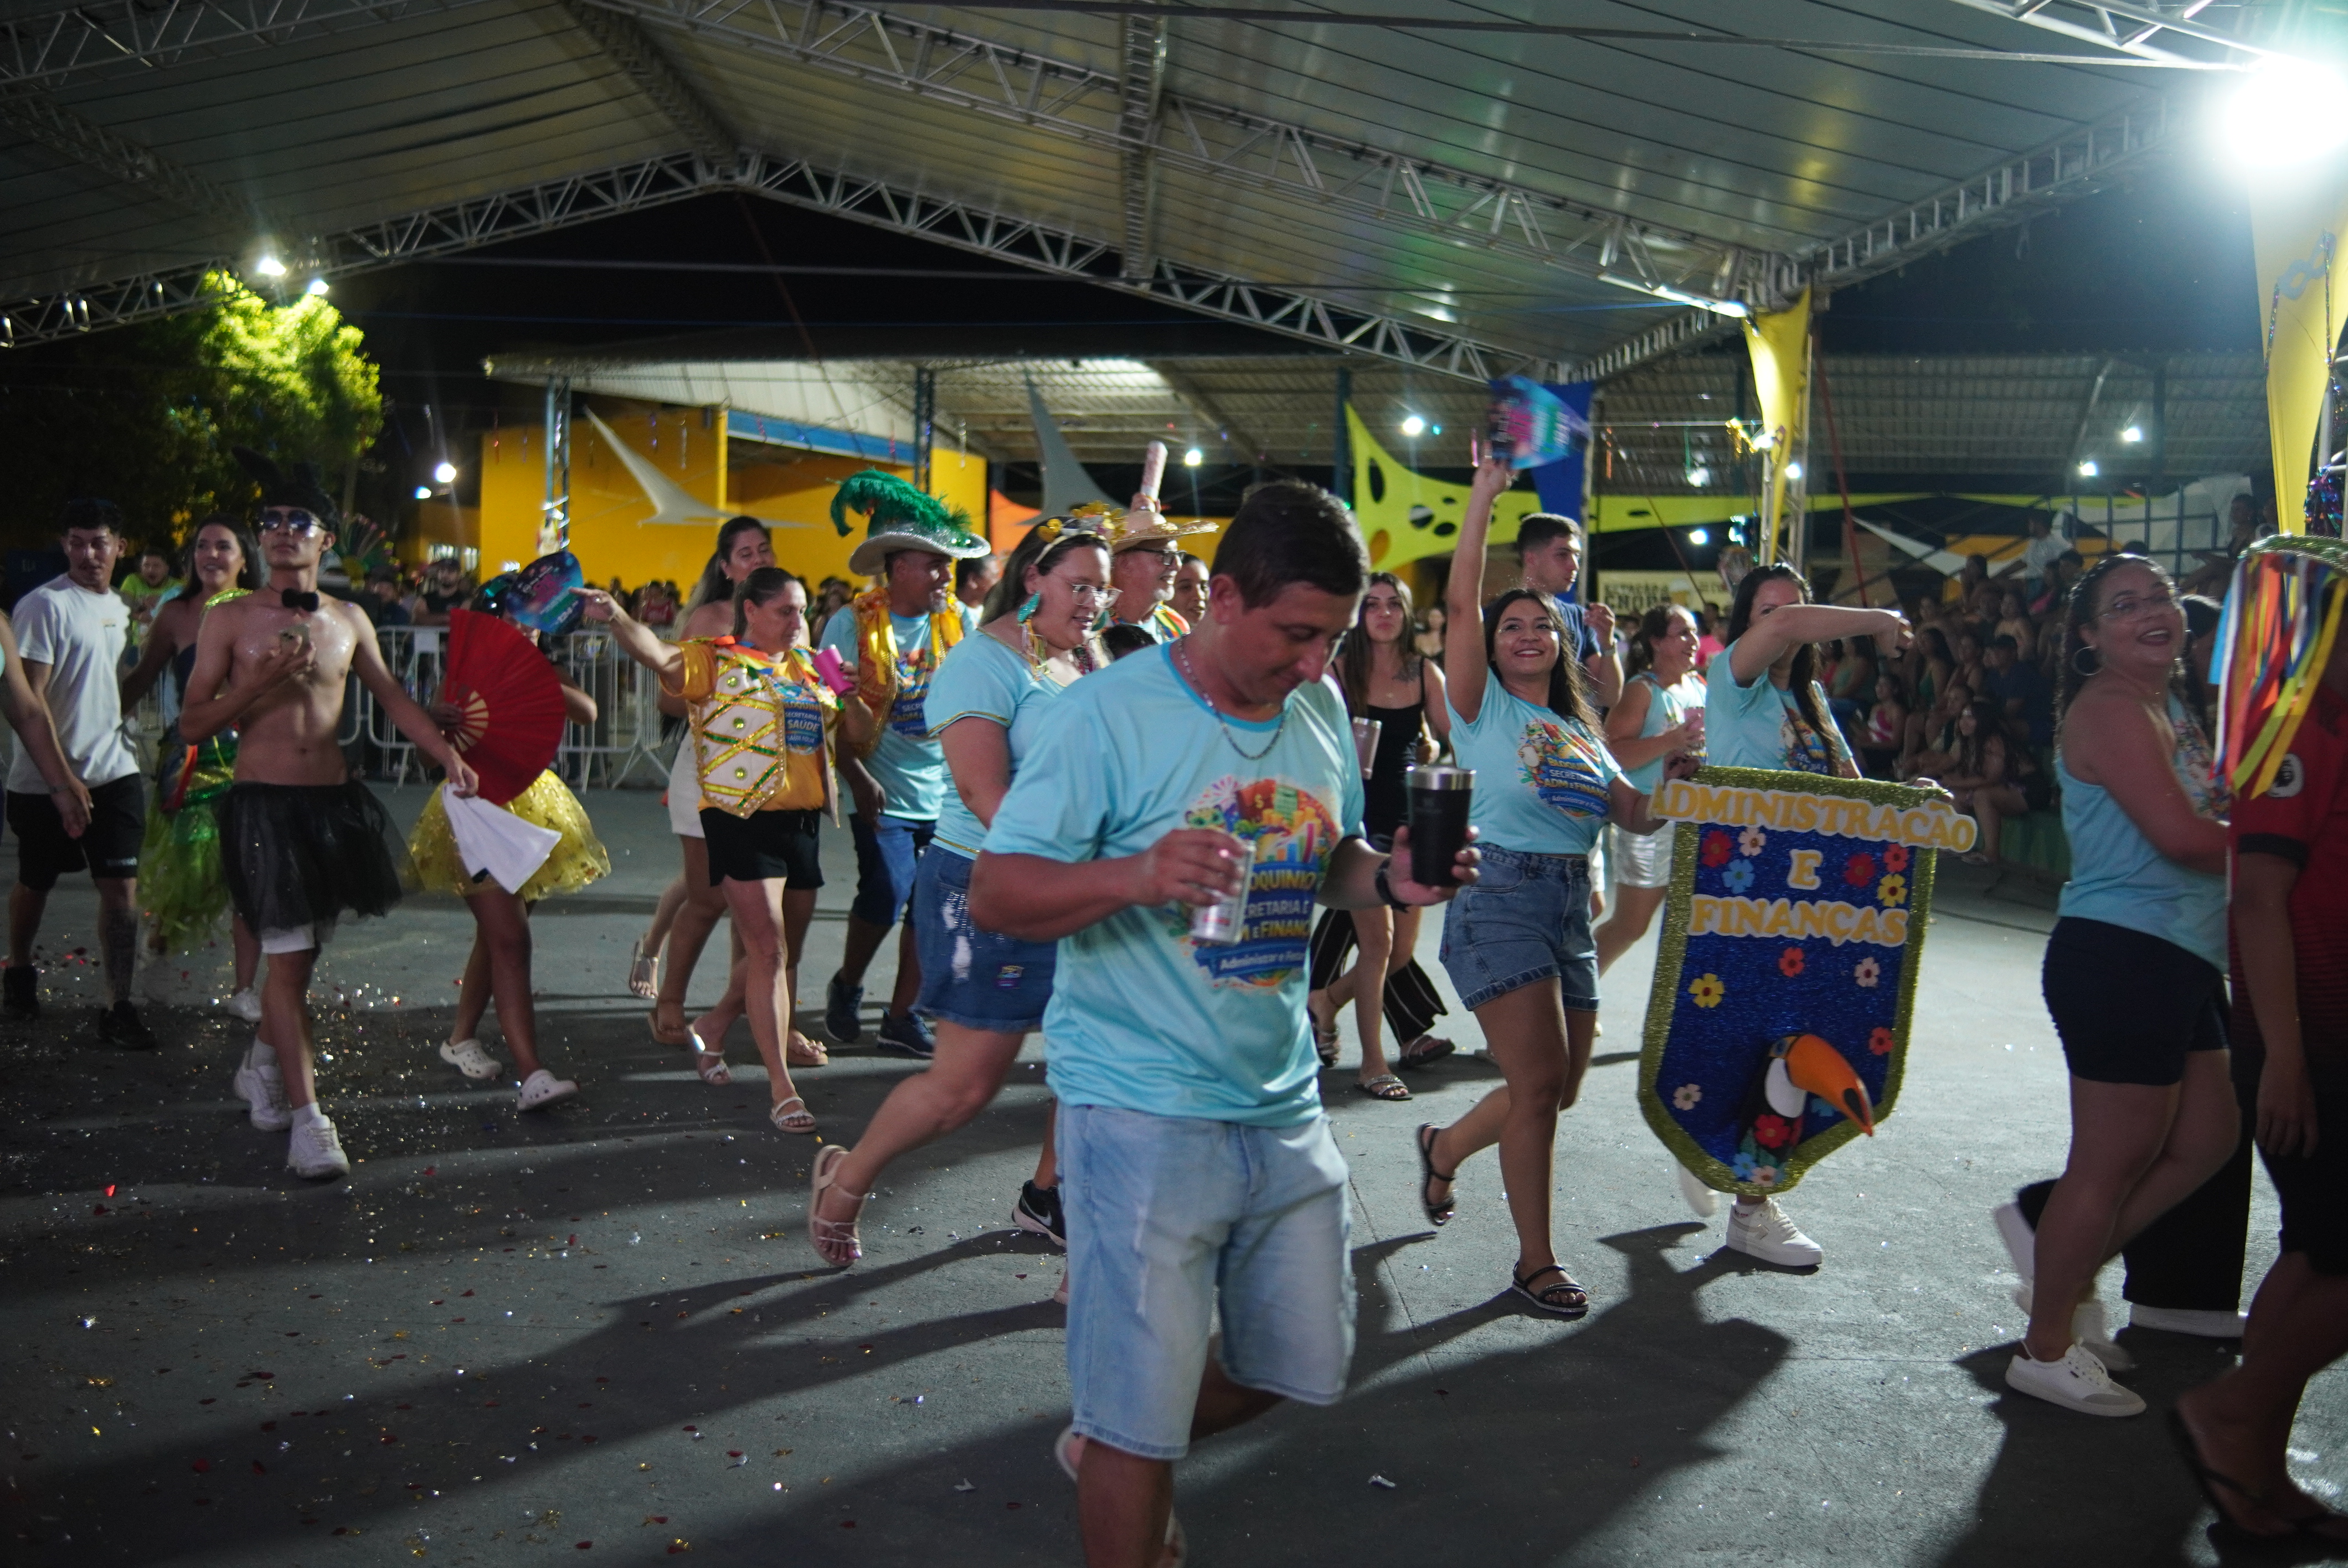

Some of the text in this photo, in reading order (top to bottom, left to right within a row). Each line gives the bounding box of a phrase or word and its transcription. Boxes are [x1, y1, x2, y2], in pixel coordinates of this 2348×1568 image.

[787, 719, 820, 733] SAÚDE
[1649, 781, 1975, 850] ADMINISTRAÇÃO
[1791, 852, 1821, 888] E
[1691, 897, 1907, 945] FINANÇAS
